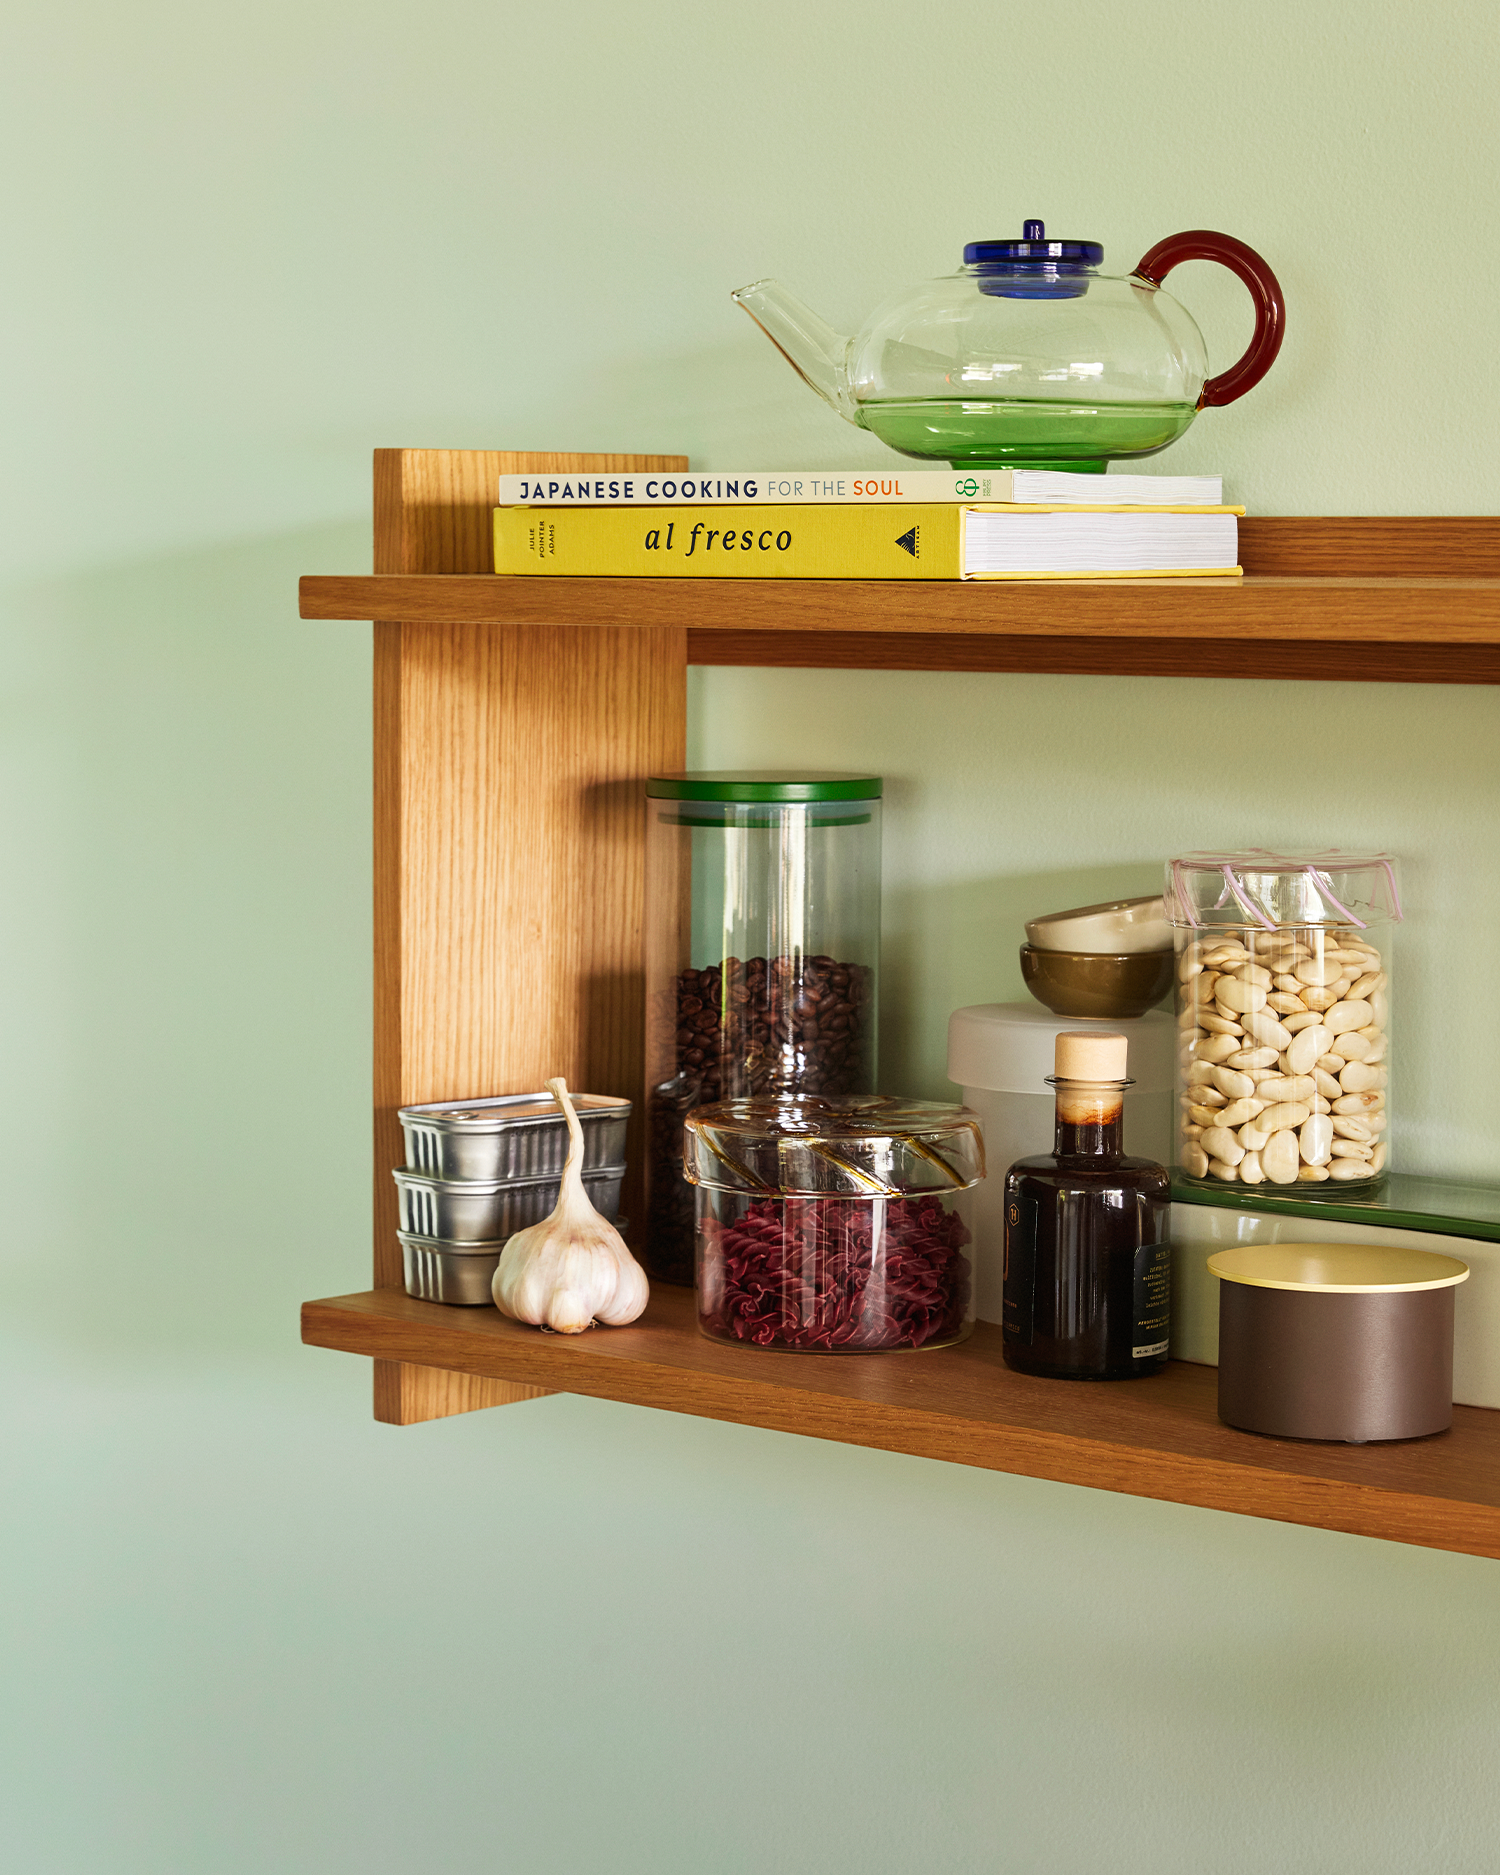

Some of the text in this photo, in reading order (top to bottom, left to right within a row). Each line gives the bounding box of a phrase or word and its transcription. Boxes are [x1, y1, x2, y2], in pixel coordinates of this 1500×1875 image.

[520, 480, 903, 499] JAPANESE COOKING FOR THE SOUL
[645, 522, 791, 557] al fresco
